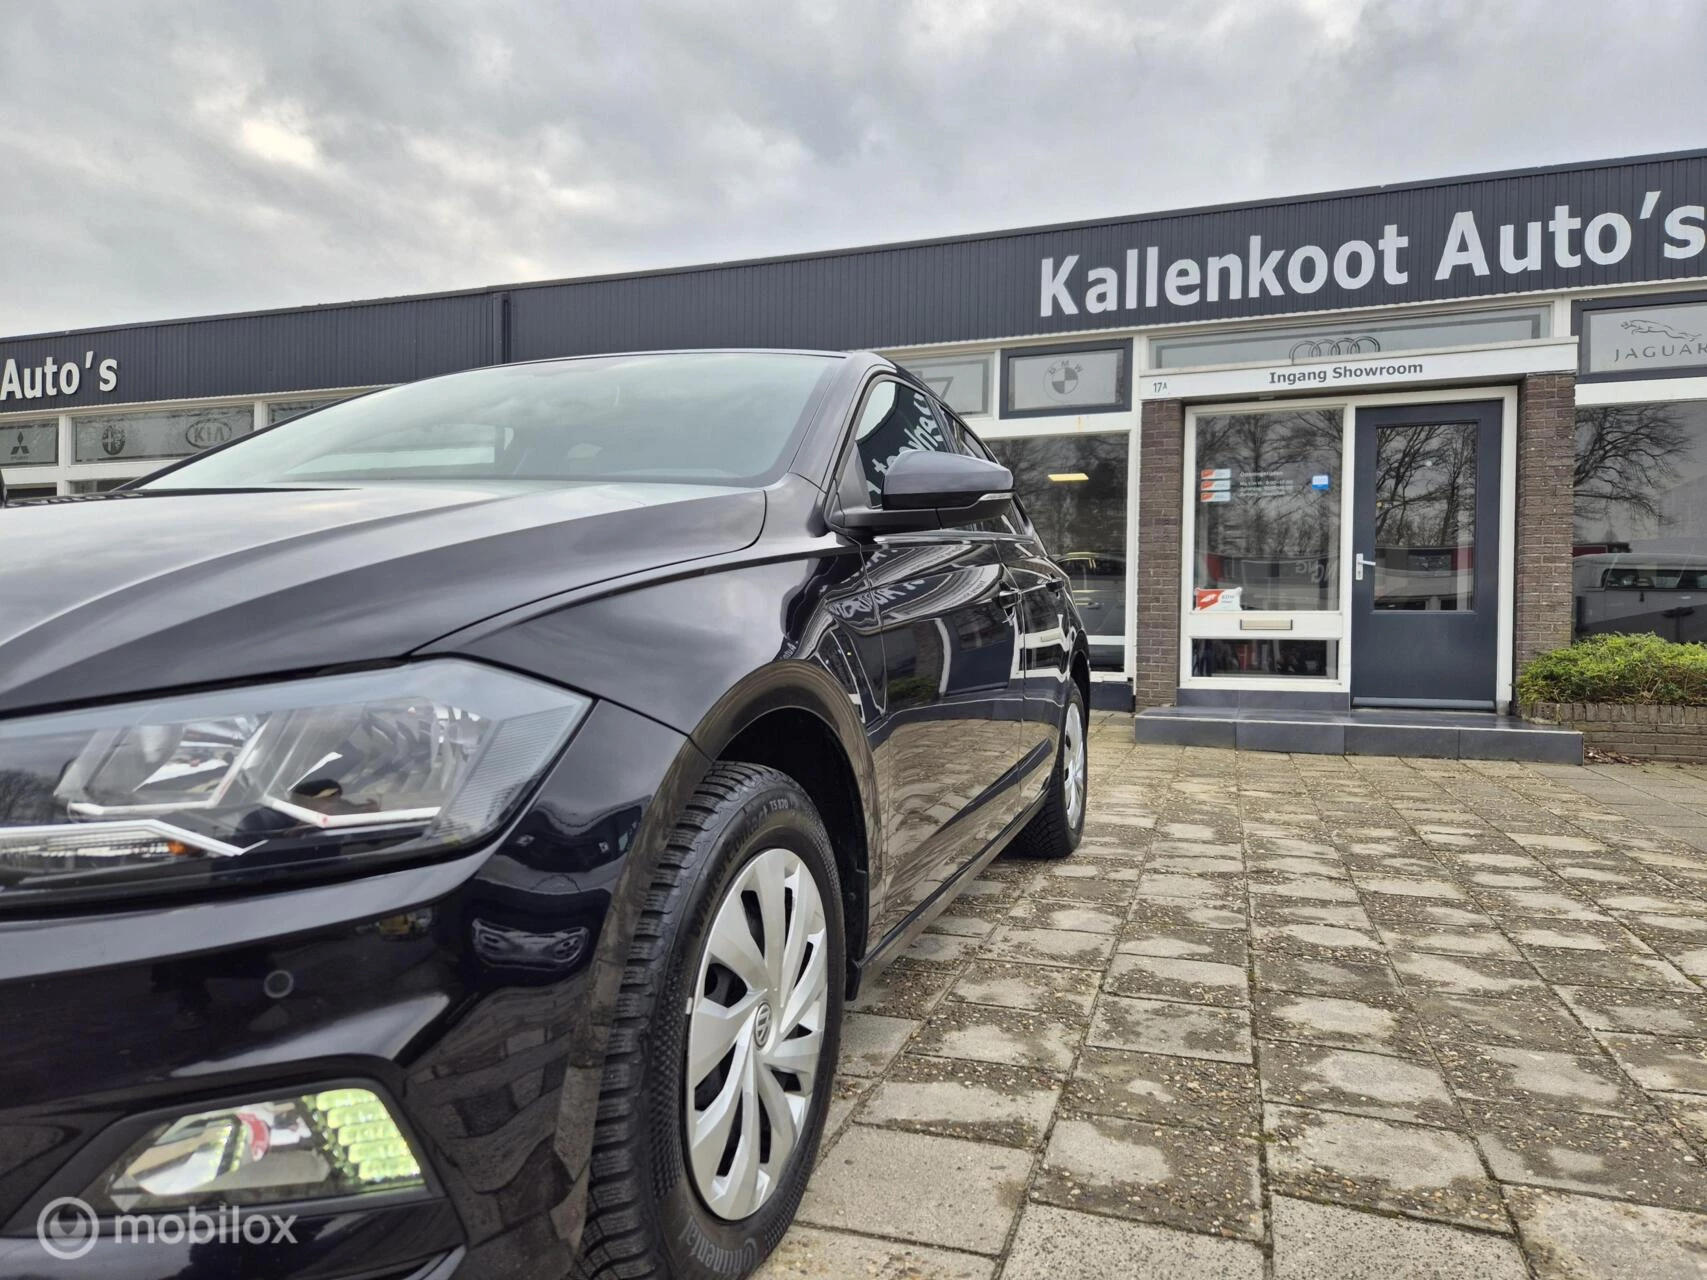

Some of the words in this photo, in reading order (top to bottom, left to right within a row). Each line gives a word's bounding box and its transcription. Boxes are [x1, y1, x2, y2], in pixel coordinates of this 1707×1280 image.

[1040, 224, 1409, 317] Kallenkoot
[1434, 189, 1706, 282] Auto's
[1614, 343, 1707, 362] JAGUAR
[0, 350, 118, 401] Auto's
[1269, 371, 1328, 385] Ingang
[1332, 363, 1424, 379] Showroom
[193, 426, 226, 444] KIA
